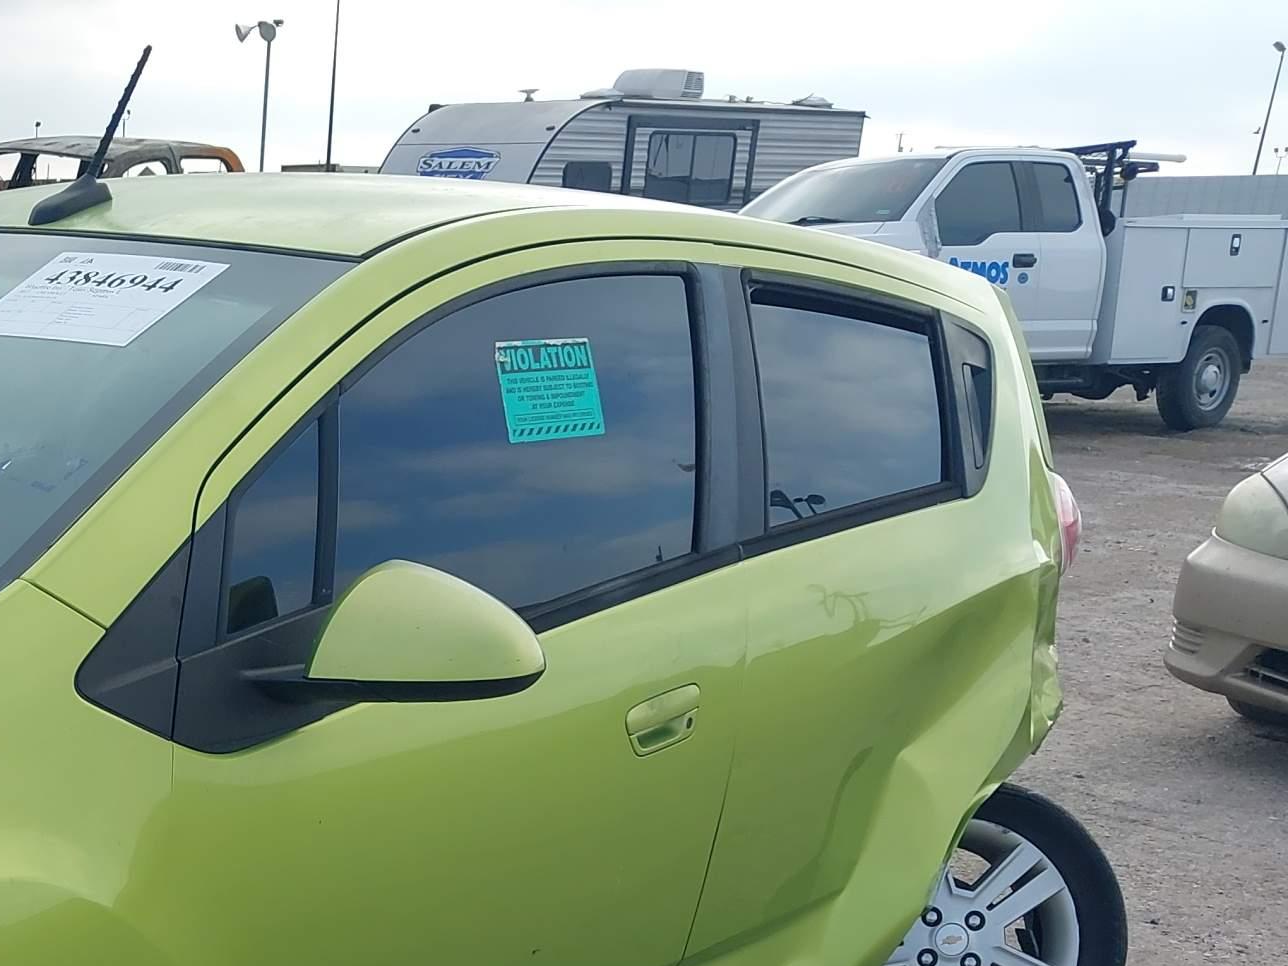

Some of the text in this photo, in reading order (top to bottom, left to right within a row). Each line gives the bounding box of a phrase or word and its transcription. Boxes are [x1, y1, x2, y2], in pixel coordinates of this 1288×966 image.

[419, 159, 493, 170] SALEM
[44, 268, 184, 294] 43846944
[501, 345, 589, 371] VIOLATION
